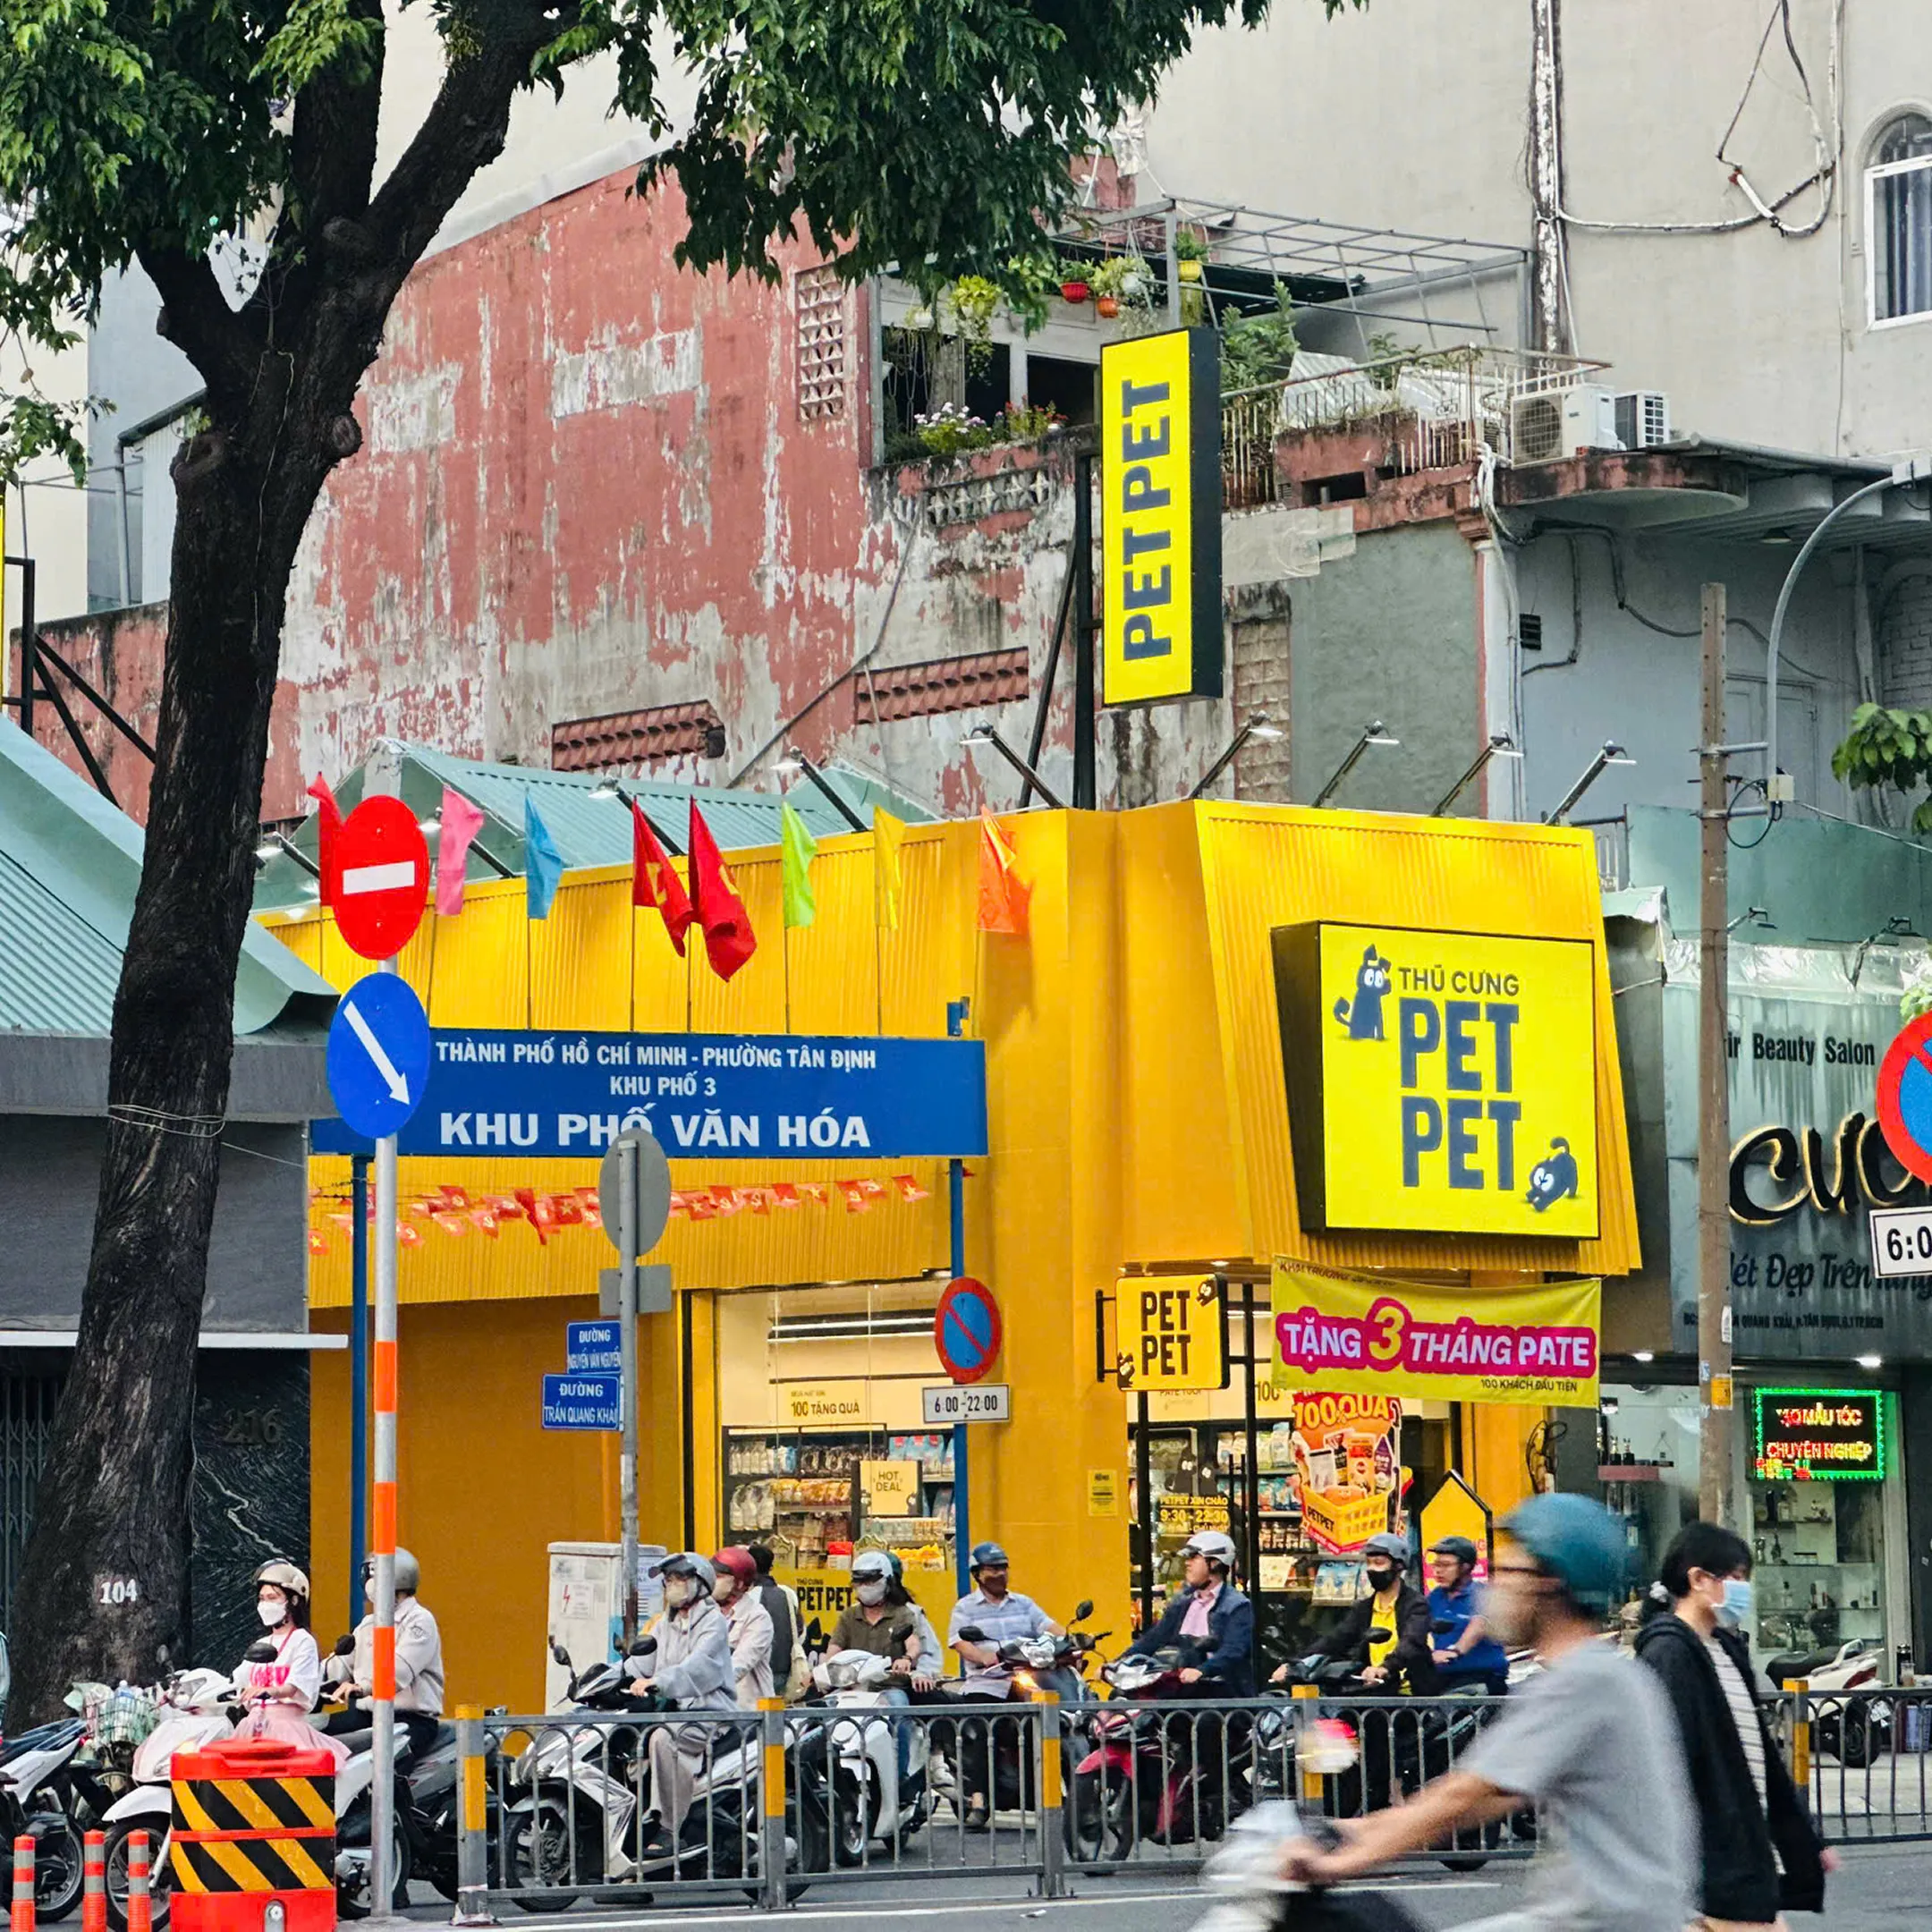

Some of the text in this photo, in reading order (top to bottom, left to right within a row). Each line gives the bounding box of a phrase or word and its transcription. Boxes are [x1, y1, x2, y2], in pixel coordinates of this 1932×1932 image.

[1122, 379, 1171, 661] PET PET
[436, 1037, 505, 1063] THÀNH
[513, 1037, 555, 1063] PHỐ
[562, 1037, 589, 1064] HỒ
[597, 1041, 631, 1065] CHÍ
[637, 1046, 687, 1066] MINH
[702, 1042, 782, 1068] PHƯỜNG
[787, 1045, 825, 1069] TÂN
[831, 1049, 876, 1072] ĐỊNH
[1398, 996, 1520, 1093] PET
[1753, 1033, 1815, 1066] Beauty
[1825, 1037, 1875, 1065] Salon
[610, 1071, 716, 1097] KHU PHỐ 3
[440, 1112, 538, 1146] KHU
[671, 1108, 759, 1147] VĂN
[778, 1106, 871, 1148] HÓA
[1401, 1095, 1521, 1191] PET
[1731, 1252, 1758, 1288] ét
[1767, 1253, 1814, 1297] Đẹp
[1820, 1254, 1872, 1289] Trên
[1140, 1291, 1191, 1331] PET
[1284, 1306, 1589, 1367] TẶNG 3 THÁNG PATE
[1141, 1334, 1191, 1375] PET
[559, 1381, 604, 1397] ĐƯỜNG
[1481, 1378, 1498, 1389] 100
[1500, 1377, 1533, 1390] KHÁCH
[568, 1406, 596, 1423] QUANG
[876, 1481, 902, 1492] DEAL
[878, 1471, 899, 1481] HOT
[100, 1579, 138, 1604] 104
[797, 1586, 854, 1611] PET PET
